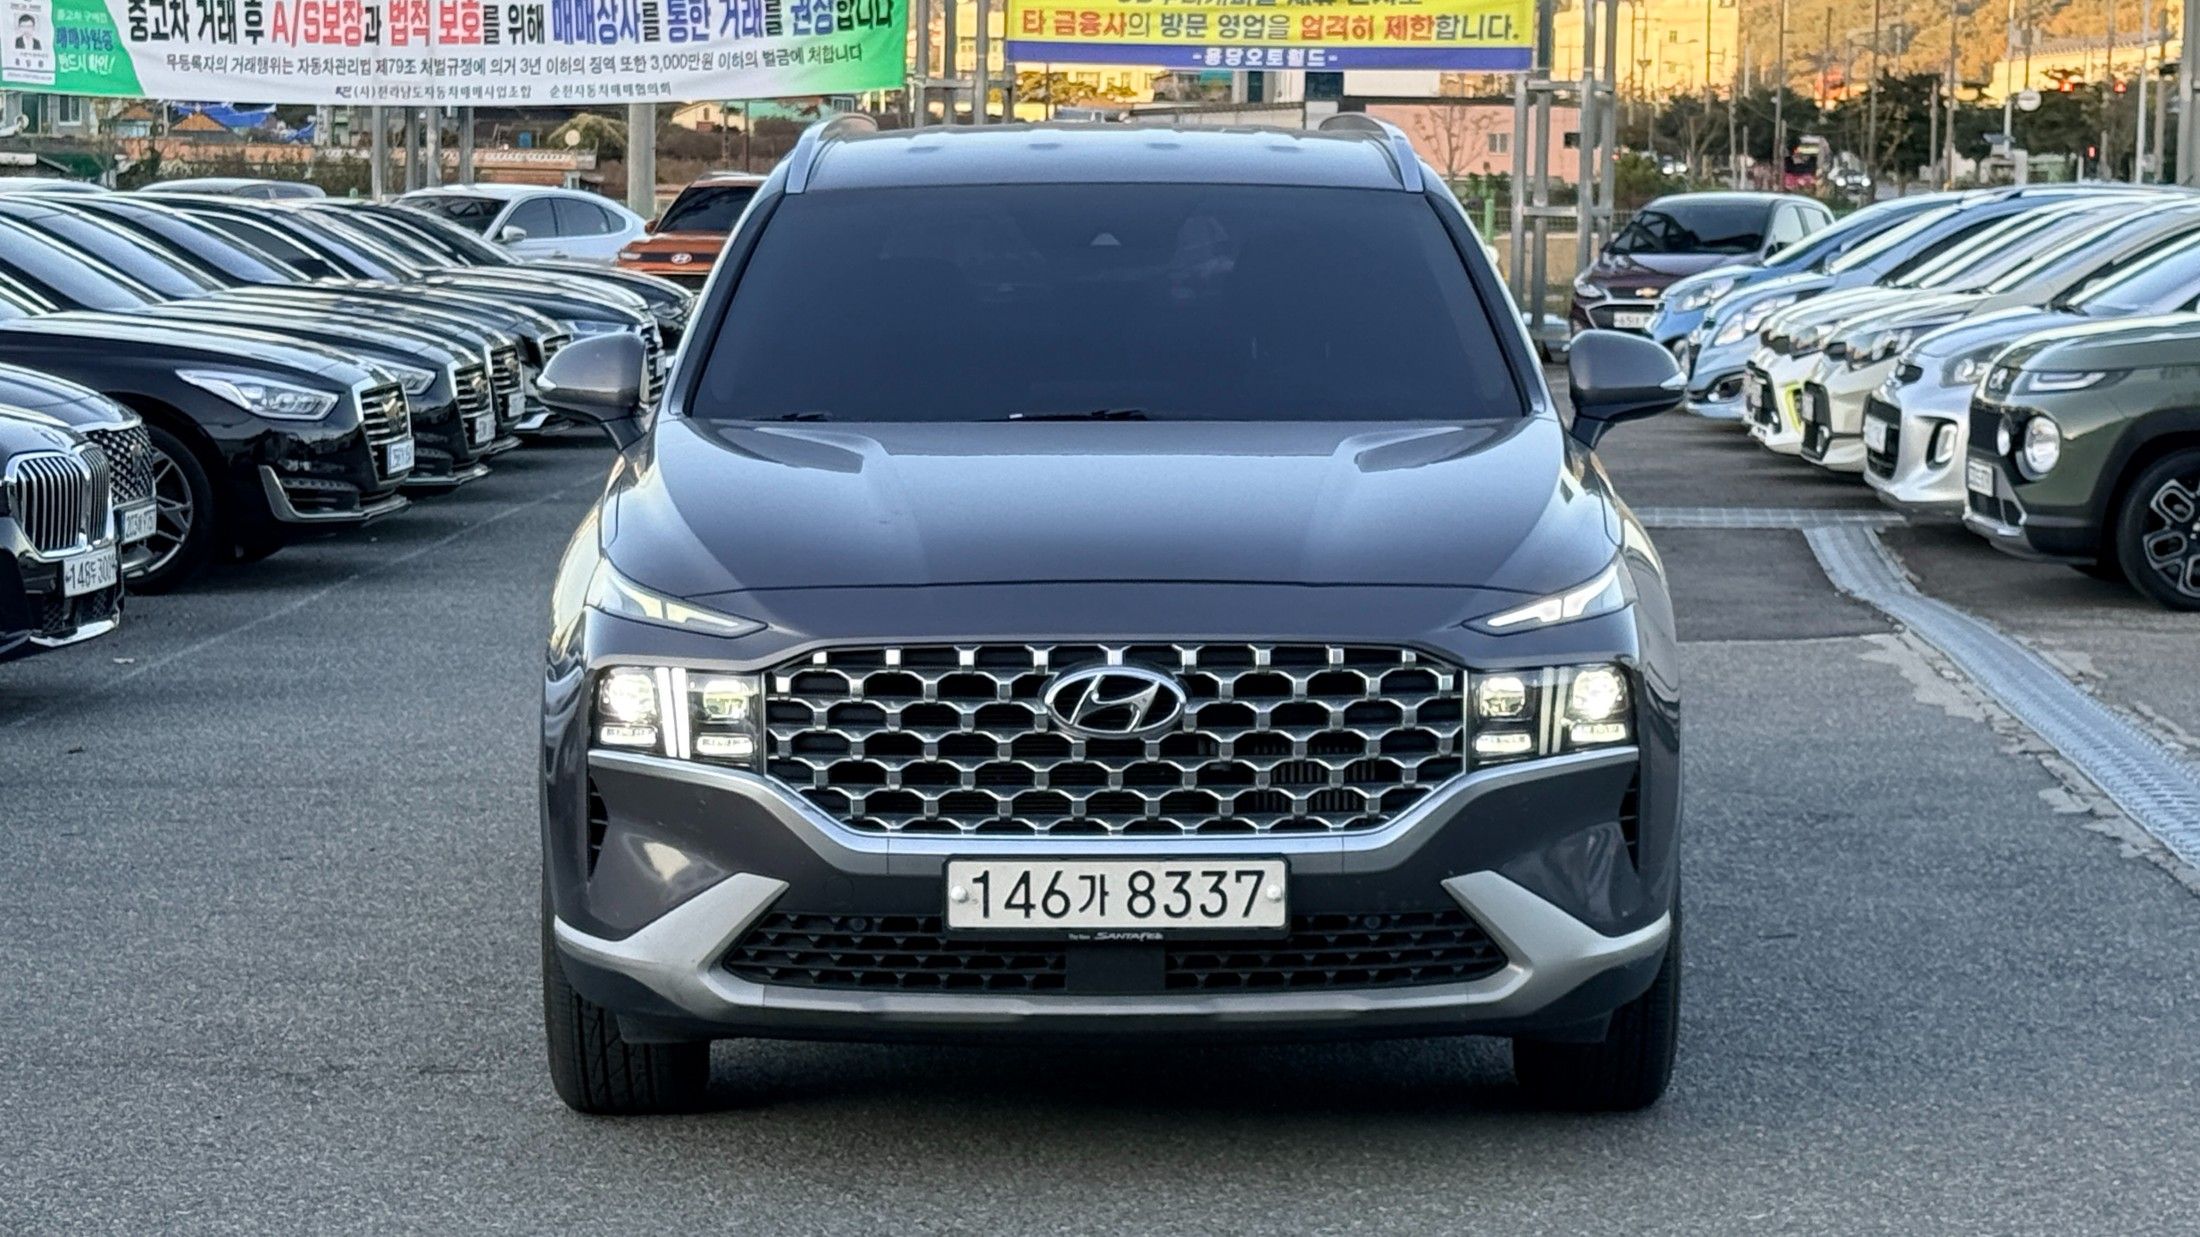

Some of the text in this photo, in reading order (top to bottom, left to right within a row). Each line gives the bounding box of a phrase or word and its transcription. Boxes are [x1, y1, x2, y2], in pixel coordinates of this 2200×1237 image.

[128, 0, 189, 43] 중고차
[196, 0, 237, 44] 거래
[244, 0, 264, 45] 후
[271, 0, 381, 47] A/S보장과
[389, 0, 430, 47] 법적
[439, 0, 500, 45] 보호를
[508, 3, 545, 45] 위해
[552, 0, 660, 45] 매매상사를
[667, 0, 710, 43] 통한
[719, 0, 783, 40] 거래를
[1022, 9, 1520, 41] 타 금융사의 방문 영업을 엄격히 제한합니다.
[166, 53, 228, 74] 무등록자의
[231, 56, 294, 75] 거래행위는
[297, 56, 372, 76] 자동차관리법
[375, 57, 417, 76] 제79조
[490, 56, 516, 76] 의거
[519, 56, 541, 76] 3년
[546, 55, 585, 75] 이하의
[589, 55, 616, 74] 징역
[619, 54, 647, 74] 또한
[650, 51, 714, 74] 3,000만원
[718, 49, 759, 71] 이하의
[807, 43, 863, 65] 처합니다
[972, 870, 1265, 919] 146가 8337
